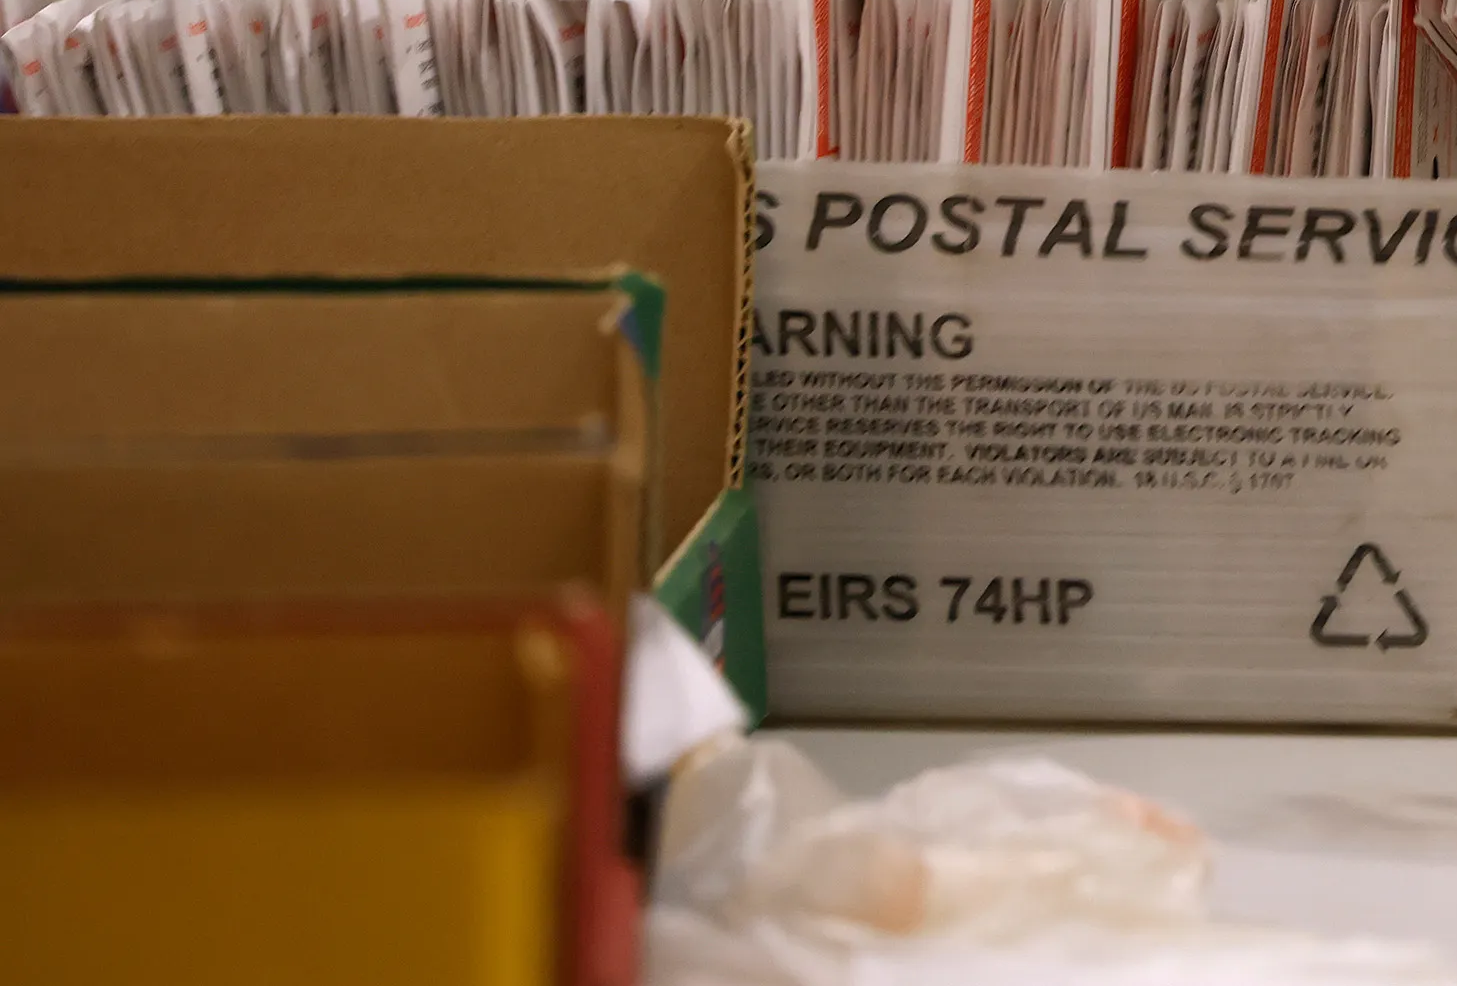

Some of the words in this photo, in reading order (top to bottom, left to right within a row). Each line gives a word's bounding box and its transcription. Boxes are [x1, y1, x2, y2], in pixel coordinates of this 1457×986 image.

[805, 192, 1148, 259] POSTAL
[801, 371, 897, 390] WITHOUT
[903, 372, 946, 392] THE
[771, 392, 846, 413] OTHER
[851, 393, 909, 415] THAN
[913, 395, 956, 416] THE
[825, 417, 939, 437] RESERVES
[944, 418, 988, 438] THE
[993, 420, 1058, 440] RIGHT
[1062, 422, 1093, 441] TO
[1098, 422, 1142, 443] USE
[1146, 423, 1284, 445] ELECTRONIC
[1289, 425, 1402, 447] TRACKING
[755, 437, 819, 457] THEIR
[963, 442, 1087, 464] VIOLATORS
[1092, 445, 1137, 465] ARE
[784, 462, 817, 482] OR
[822, 463, 883, 484] BOTH
[887, 464, 932, 485] FOR
[937, 465, 998, 486] EACH
[777, 572, 920, 622] EIRS
[939, 576, 1095, 625] 74HP
